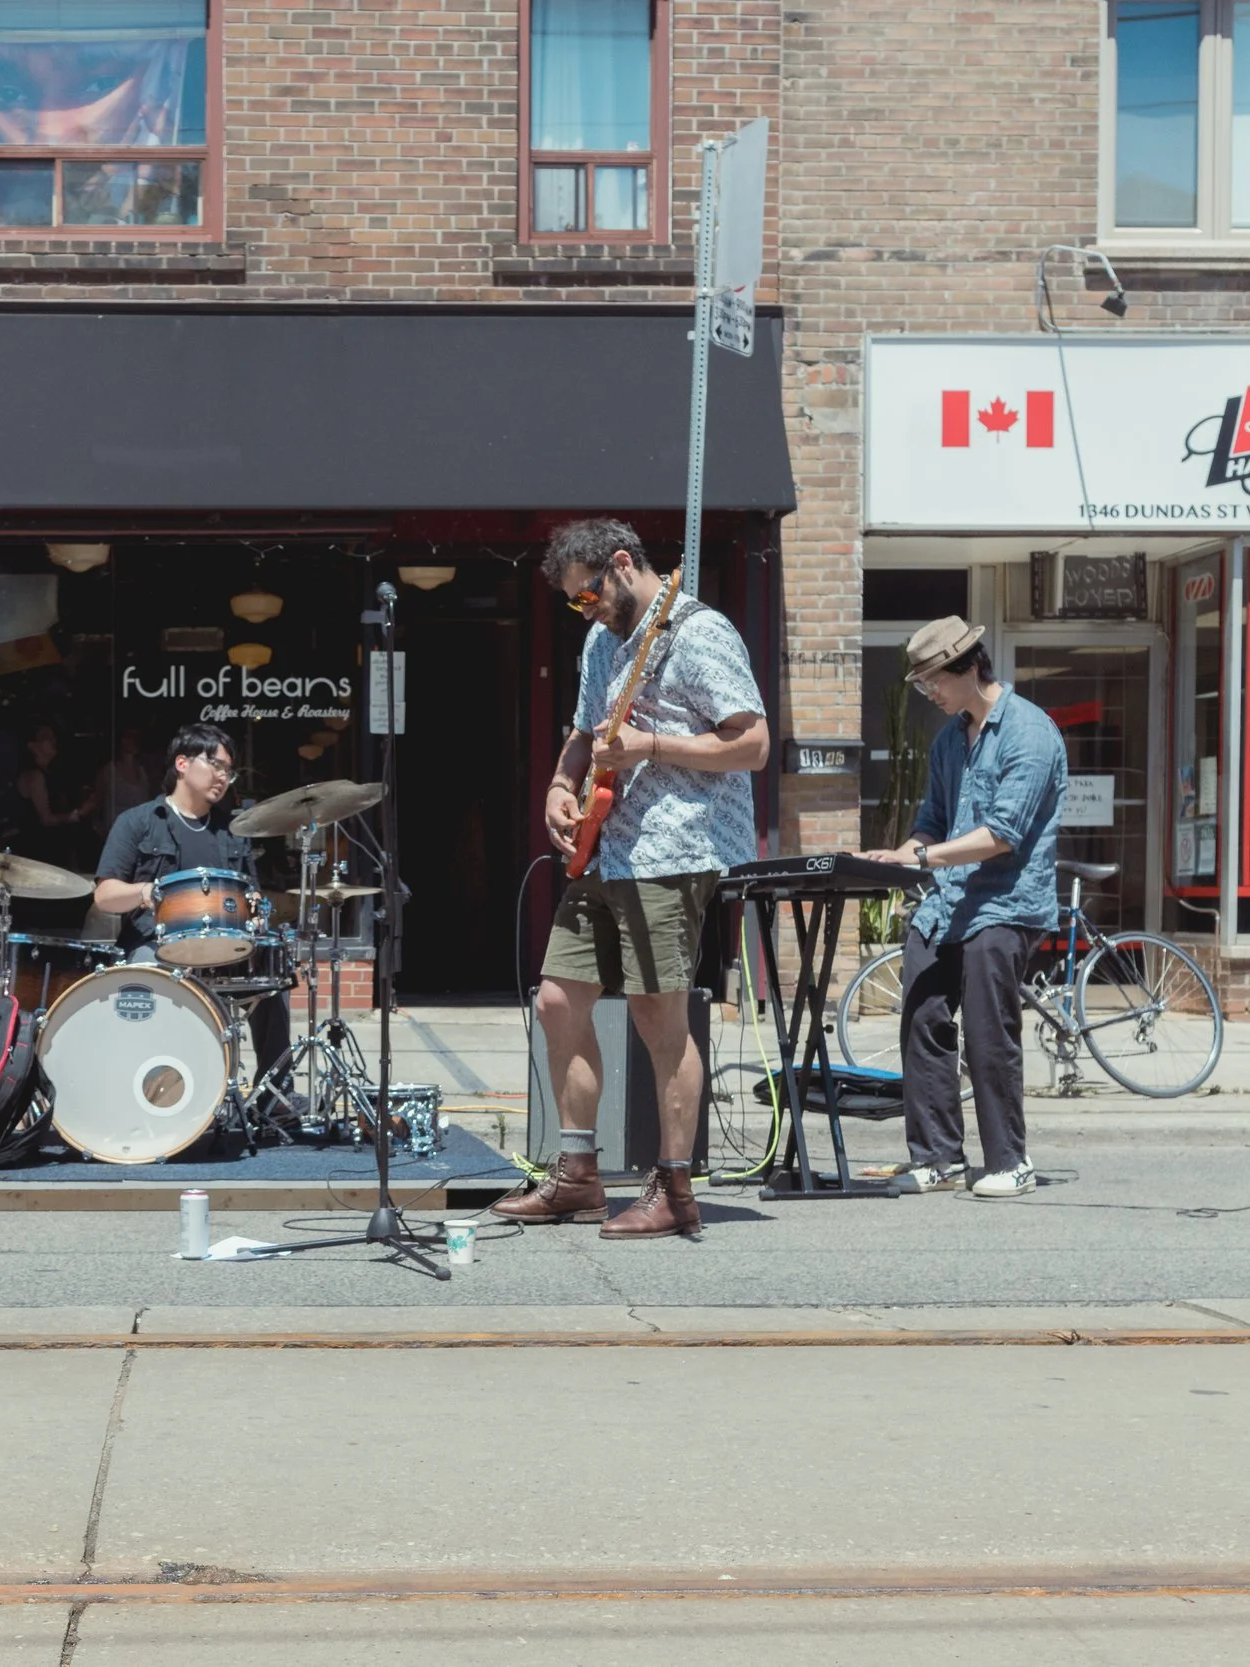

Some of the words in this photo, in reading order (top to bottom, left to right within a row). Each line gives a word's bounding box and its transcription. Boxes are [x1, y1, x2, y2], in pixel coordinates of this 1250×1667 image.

[1079, 504, 1120, 519] 1346
[1125, 504, 1211, 519] DUNDAS
[1217, 504, 1240, 519] ST
[123, 665, 185, 698] full
[197, 666, 232, 698] of
[241, 665, 351, 698] beans
[200, 704, 239, 722] Coffee
[240, 703, 279, 721] House
[281, 704, 294, 719] &
[297, 704, 351, 722] Roastery
[806, 857, 833, 870] CK61
